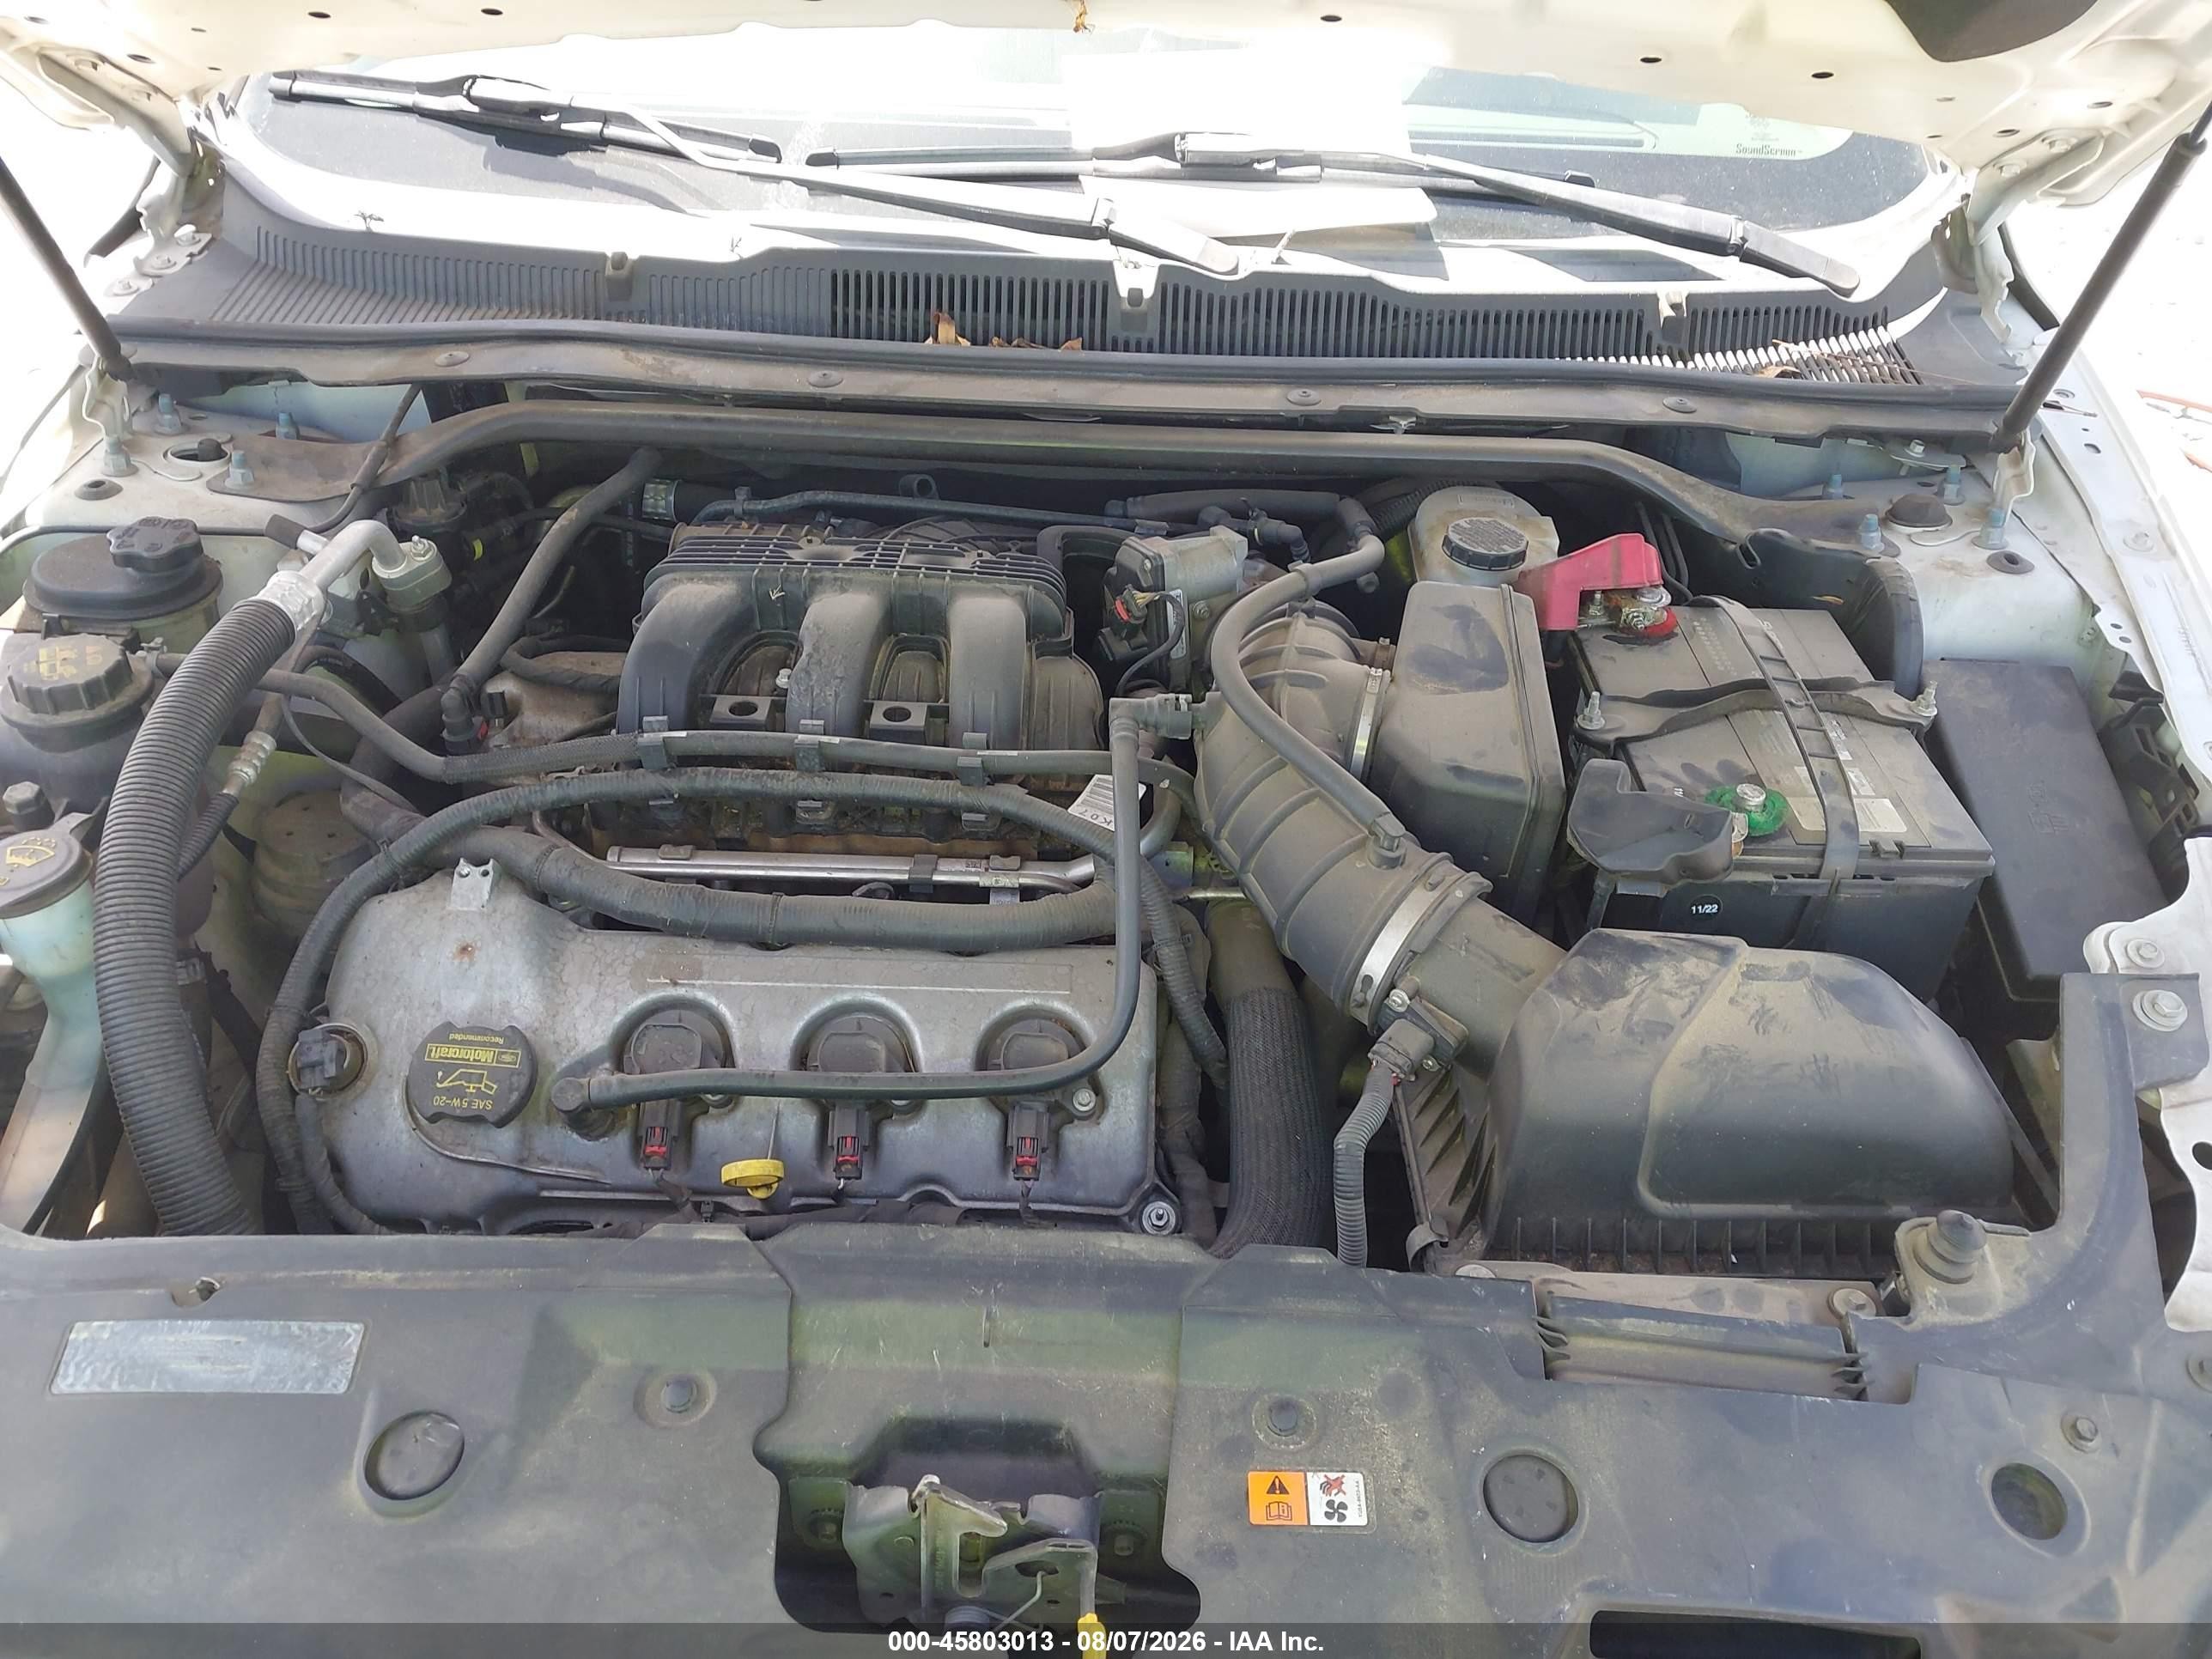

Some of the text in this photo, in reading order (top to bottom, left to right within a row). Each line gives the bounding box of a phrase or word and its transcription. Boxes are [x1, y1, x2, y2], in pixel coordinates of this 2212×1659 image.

[1691, 904, 1718, 915] 11/22
[449, 1033, 505, 1045] Recommended
[430, 1047, 495, 1063] Motorcraft
[471, 1098, 494, 1110] SAE
